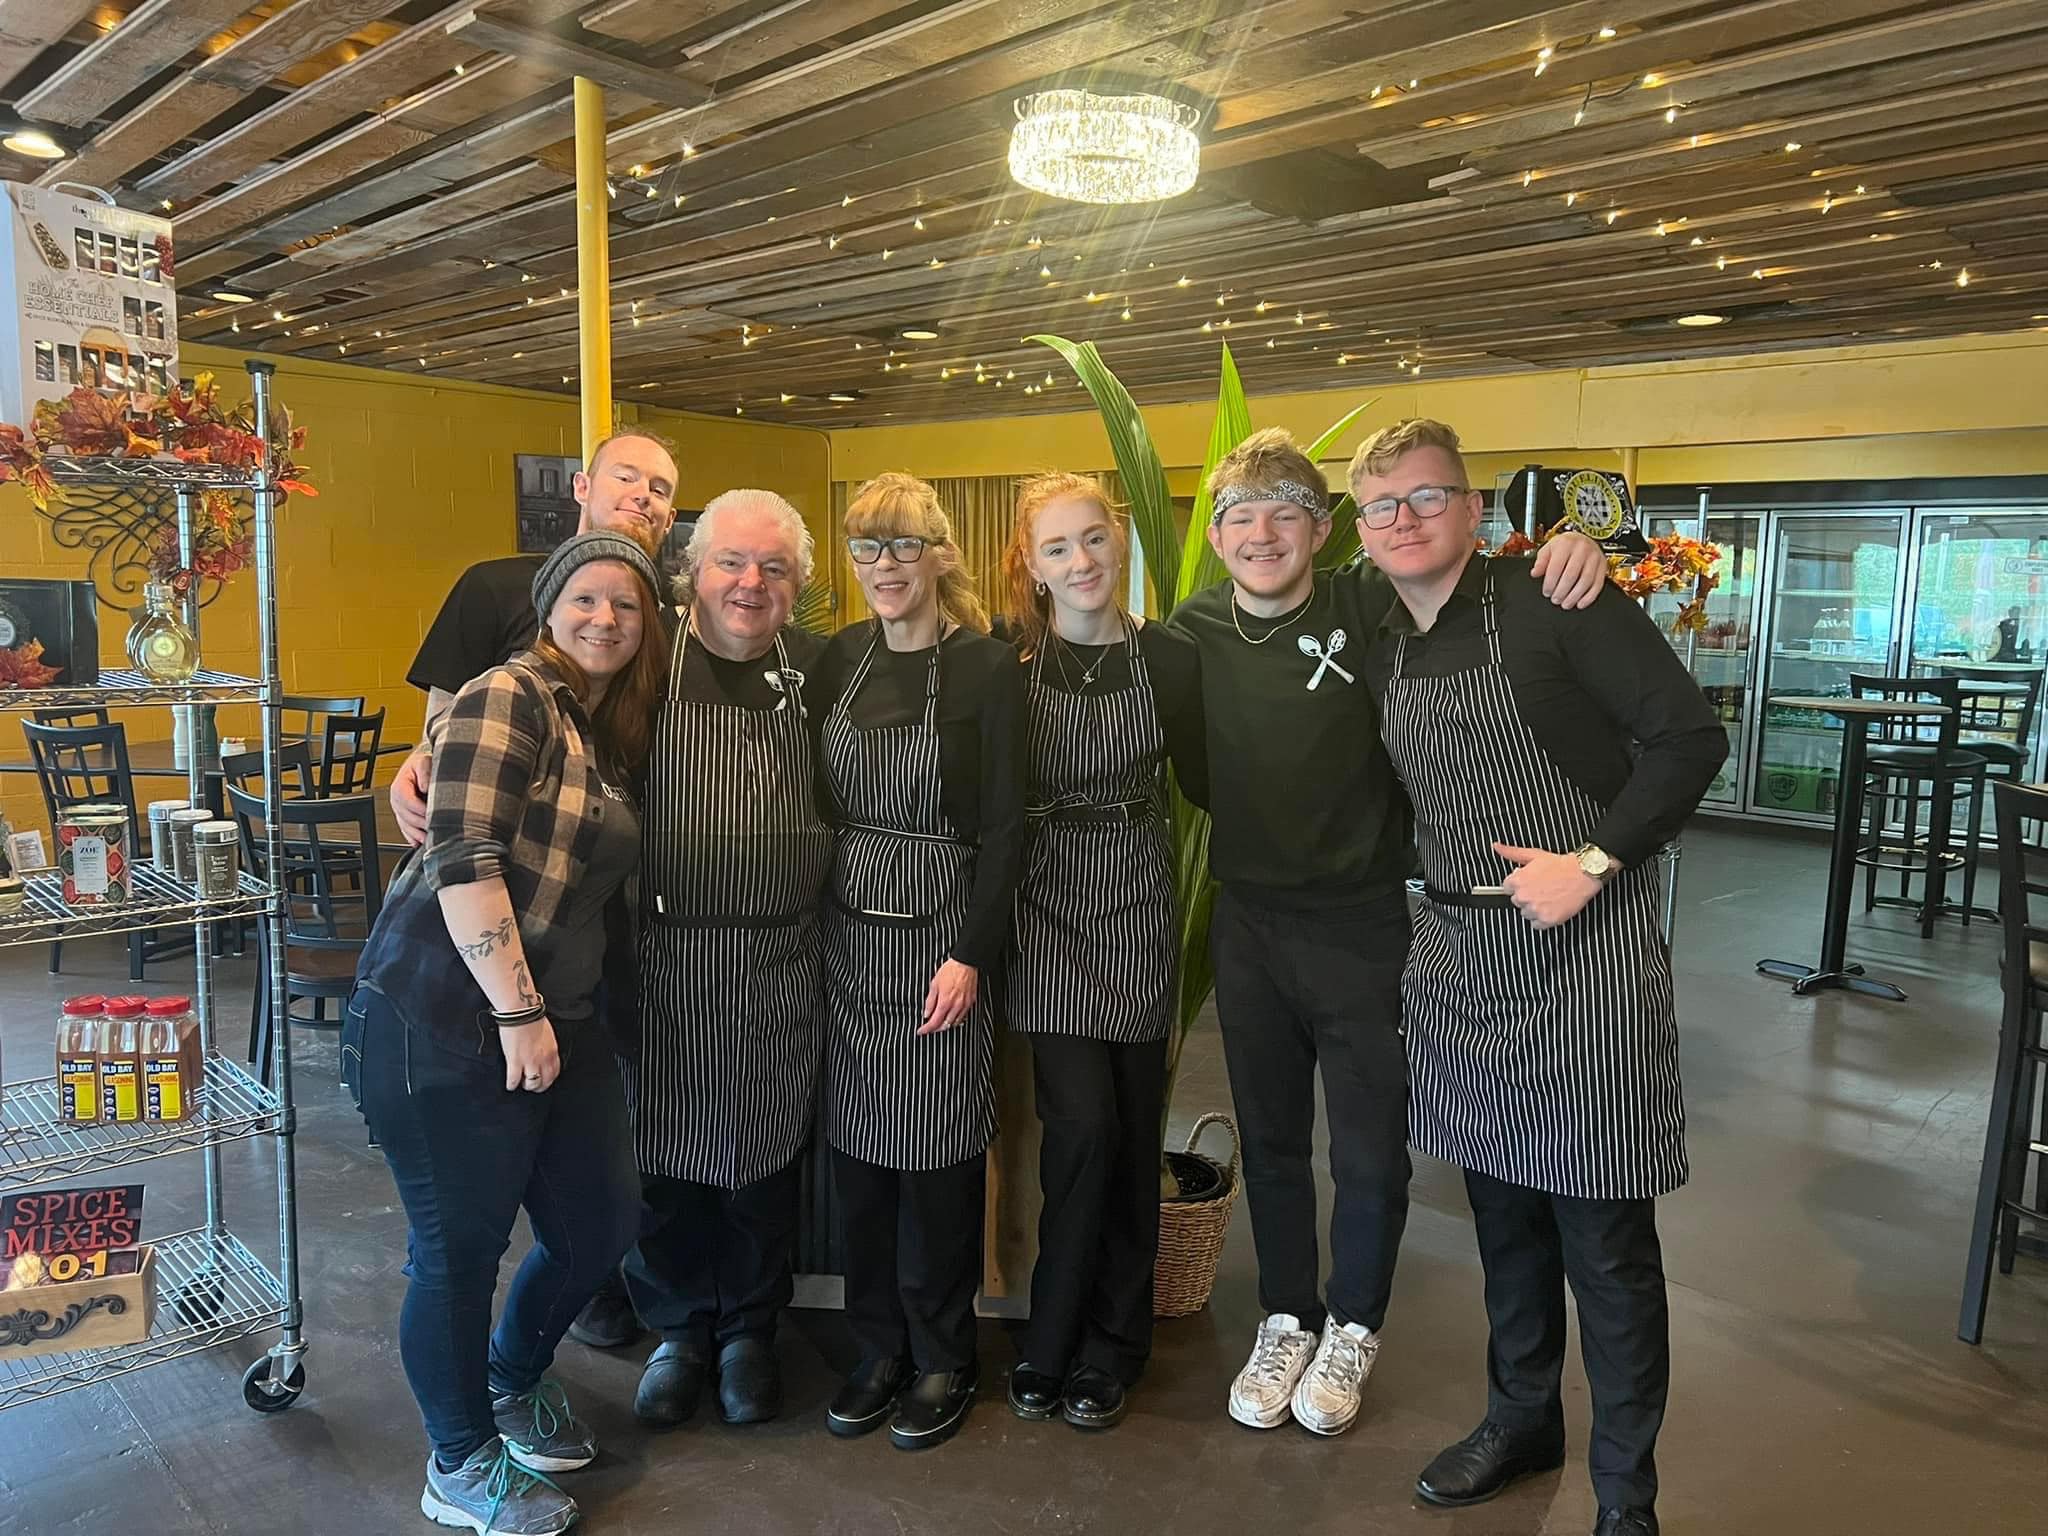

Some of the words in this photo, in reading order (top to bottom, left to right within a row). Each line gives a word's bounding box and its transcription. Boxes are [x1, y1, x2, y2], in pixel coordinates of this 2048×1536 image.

[28, 281, 73, 301] HOME
[77, 288, 114, 308] CHEF
[24, 294, 119, 323] ESSENTIALS
[61, 1063, 76, 1073] OLD
[77, 1063, 93, 1072] BAY
[102, 1065, 116, 1074] OLD
[117, 1065, 134, 1073] BAY
[146, 1063, 160, 1073] OLD
[162, 1063, 177, 1072] BAY
[14, 1188, 127, 1226] SPICE
[4, 1219, 134, 1258] MIXES
